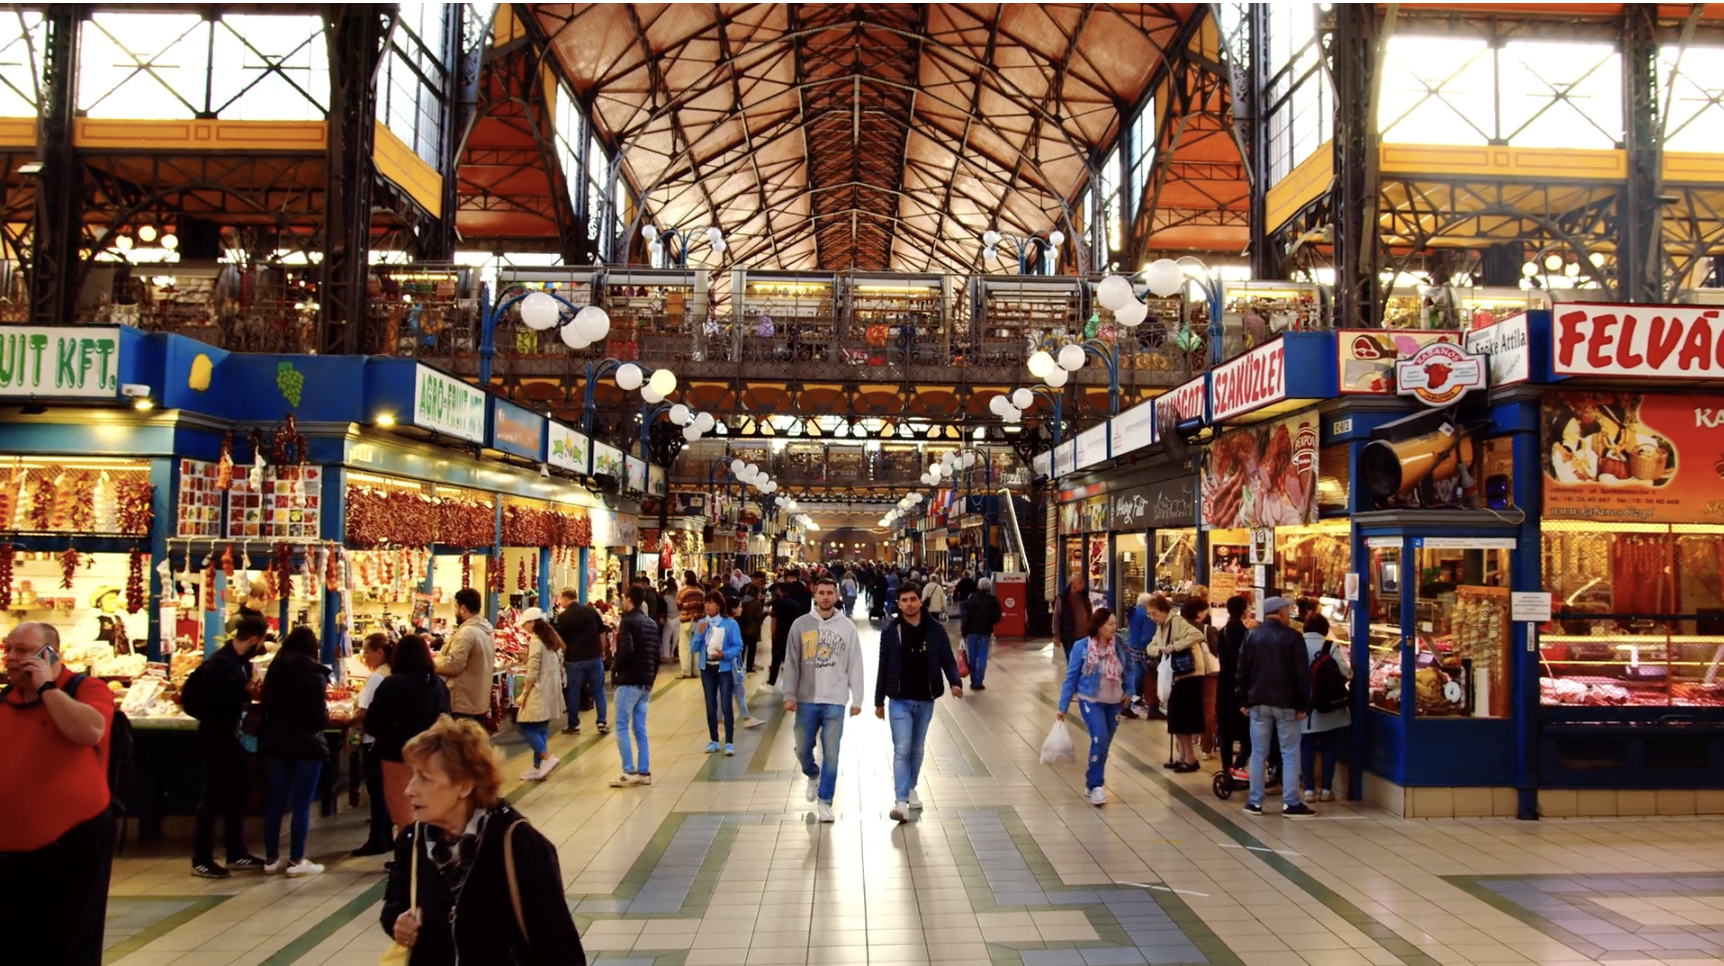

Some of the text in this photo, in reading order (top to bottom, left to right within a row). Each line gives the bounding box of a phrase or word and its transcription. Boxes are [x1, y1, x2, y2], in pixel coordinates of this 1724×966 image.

[0, 333, 116, 390] UIT KFT.
[1416, 346, 1460, 365] KABANOS
[1500, 328, 1526, 353] Attila
[1559, 311, 1724, 371] FELVÁ
[1214, 347, 1284, 415] SZAKÜZLET
